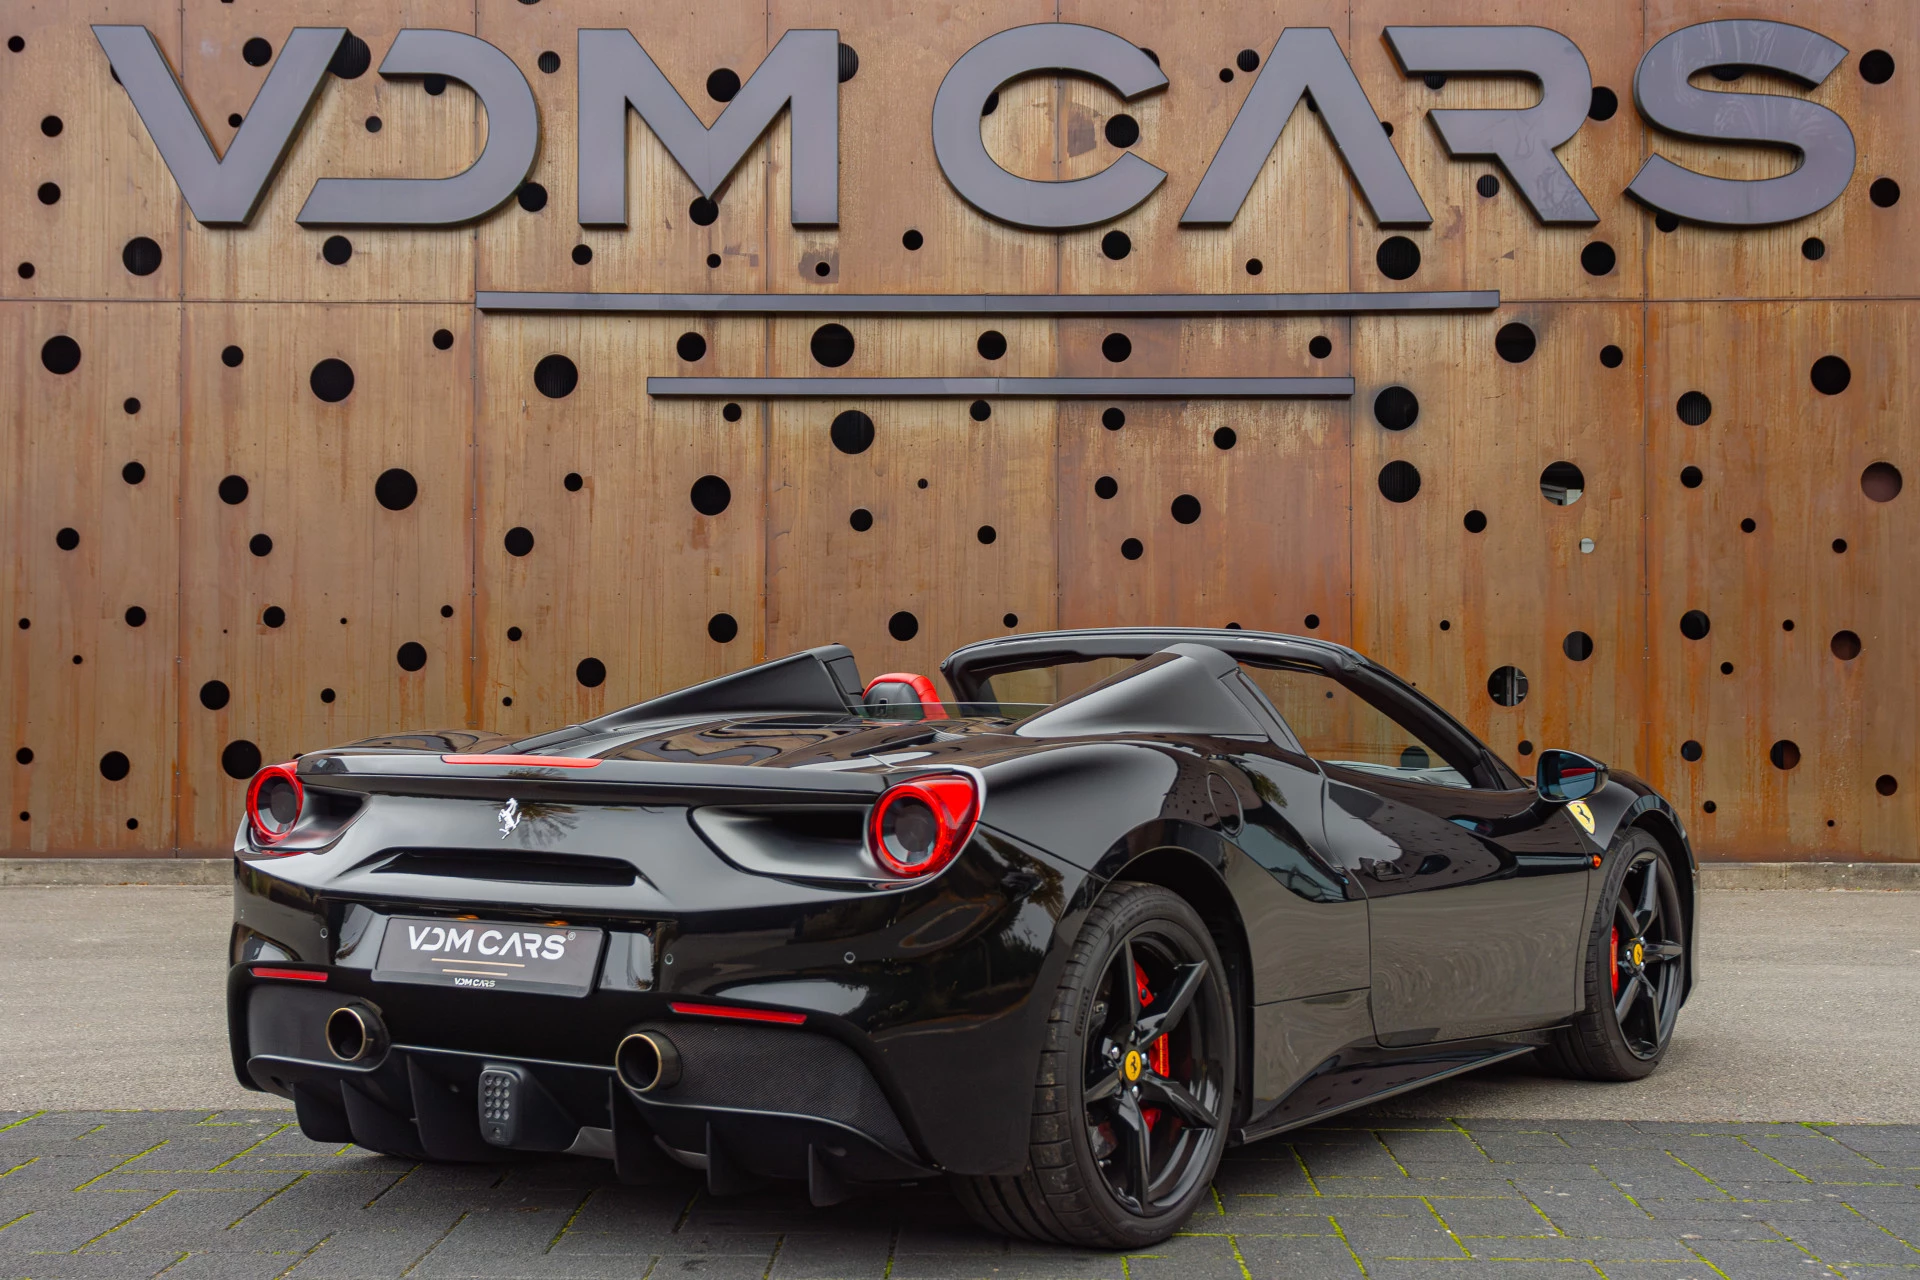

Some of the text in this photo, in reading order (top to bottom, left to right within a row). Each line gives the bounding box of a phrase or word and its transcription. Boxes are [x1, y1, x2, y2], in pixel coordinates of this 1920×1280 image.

[90, 18, 1857, 230] VDM CARS
[408, 925, 475, 954] VDM
